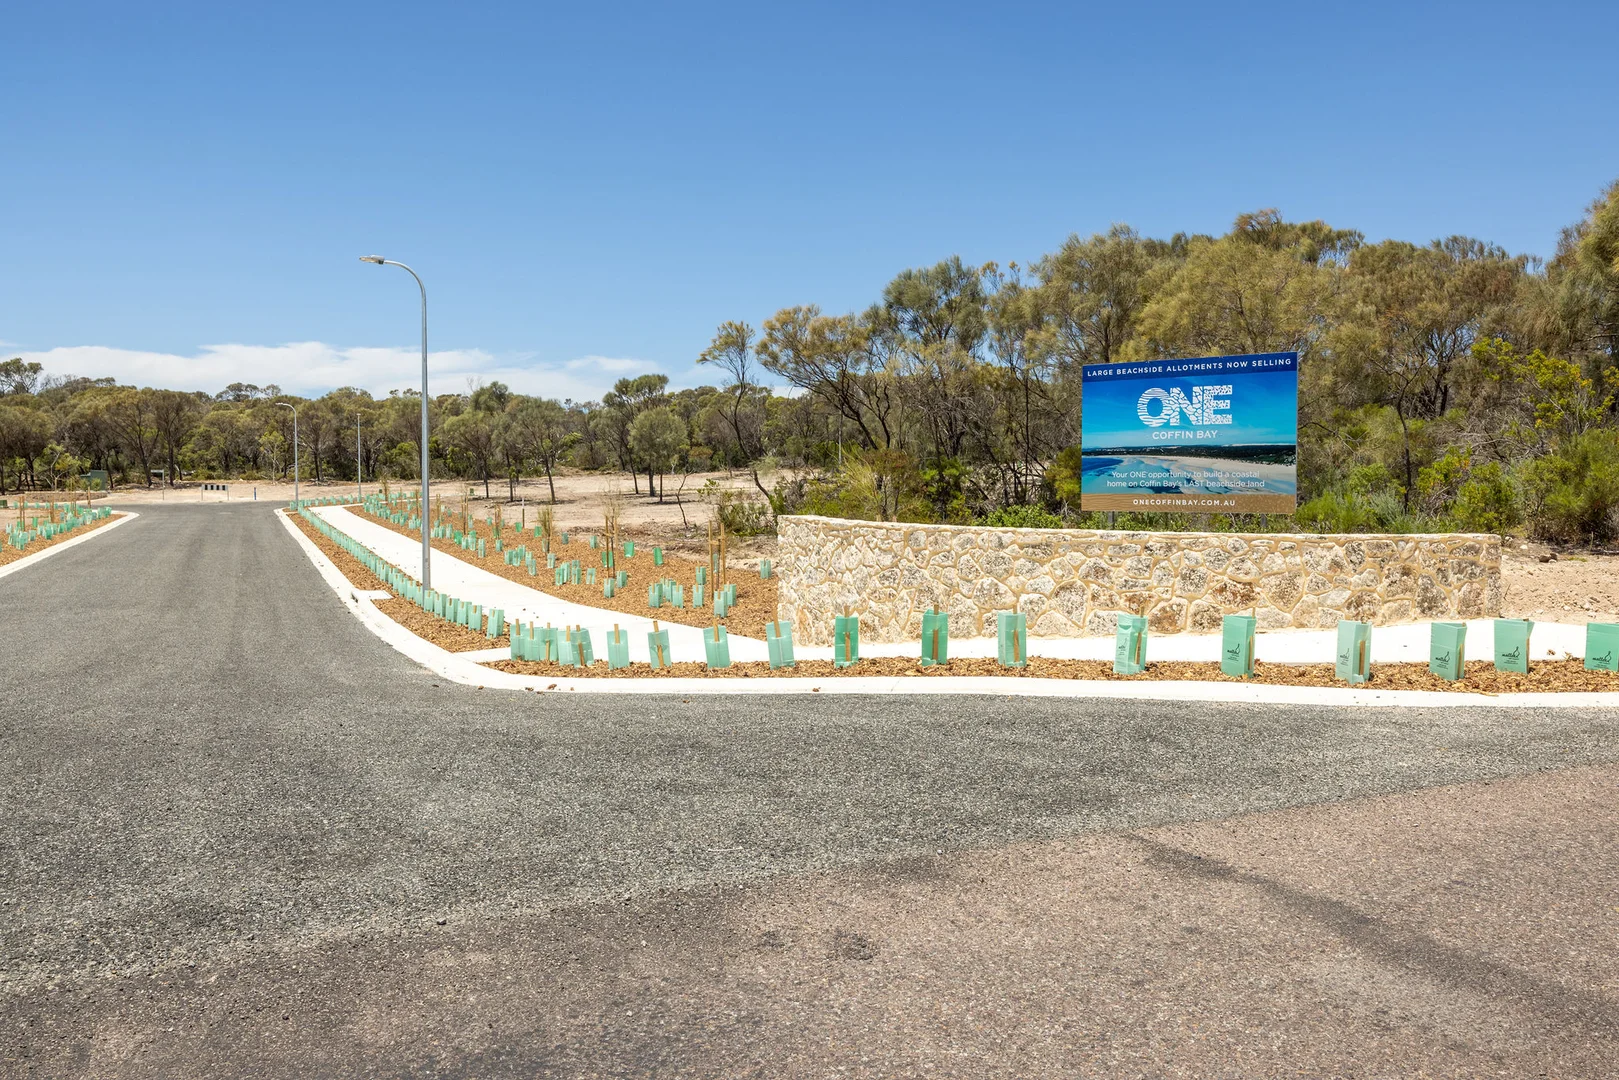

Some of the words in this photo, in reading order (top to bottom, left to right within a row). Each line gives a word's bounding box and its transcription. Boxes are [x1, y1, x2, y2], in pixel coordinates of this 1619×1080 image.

[1087, 369, 1113, 377] LARGE
[1116, 366, 1163, 375] BEACHSIDE
[1166, 362, 1223, 372] ALLOTMENTS
[1226, 361, 1248, 369] NOW
[1252, 358, 1292, 367] SELLING
[1137, 385, 1232, 427] ONE
[1152, 431, 1193, 440] COFFIN
[1196, 430, 1218, 439] BAY
[1148, 471, 1192, 479] opportunity
[1163, 480, 1182, 488] Bay's
